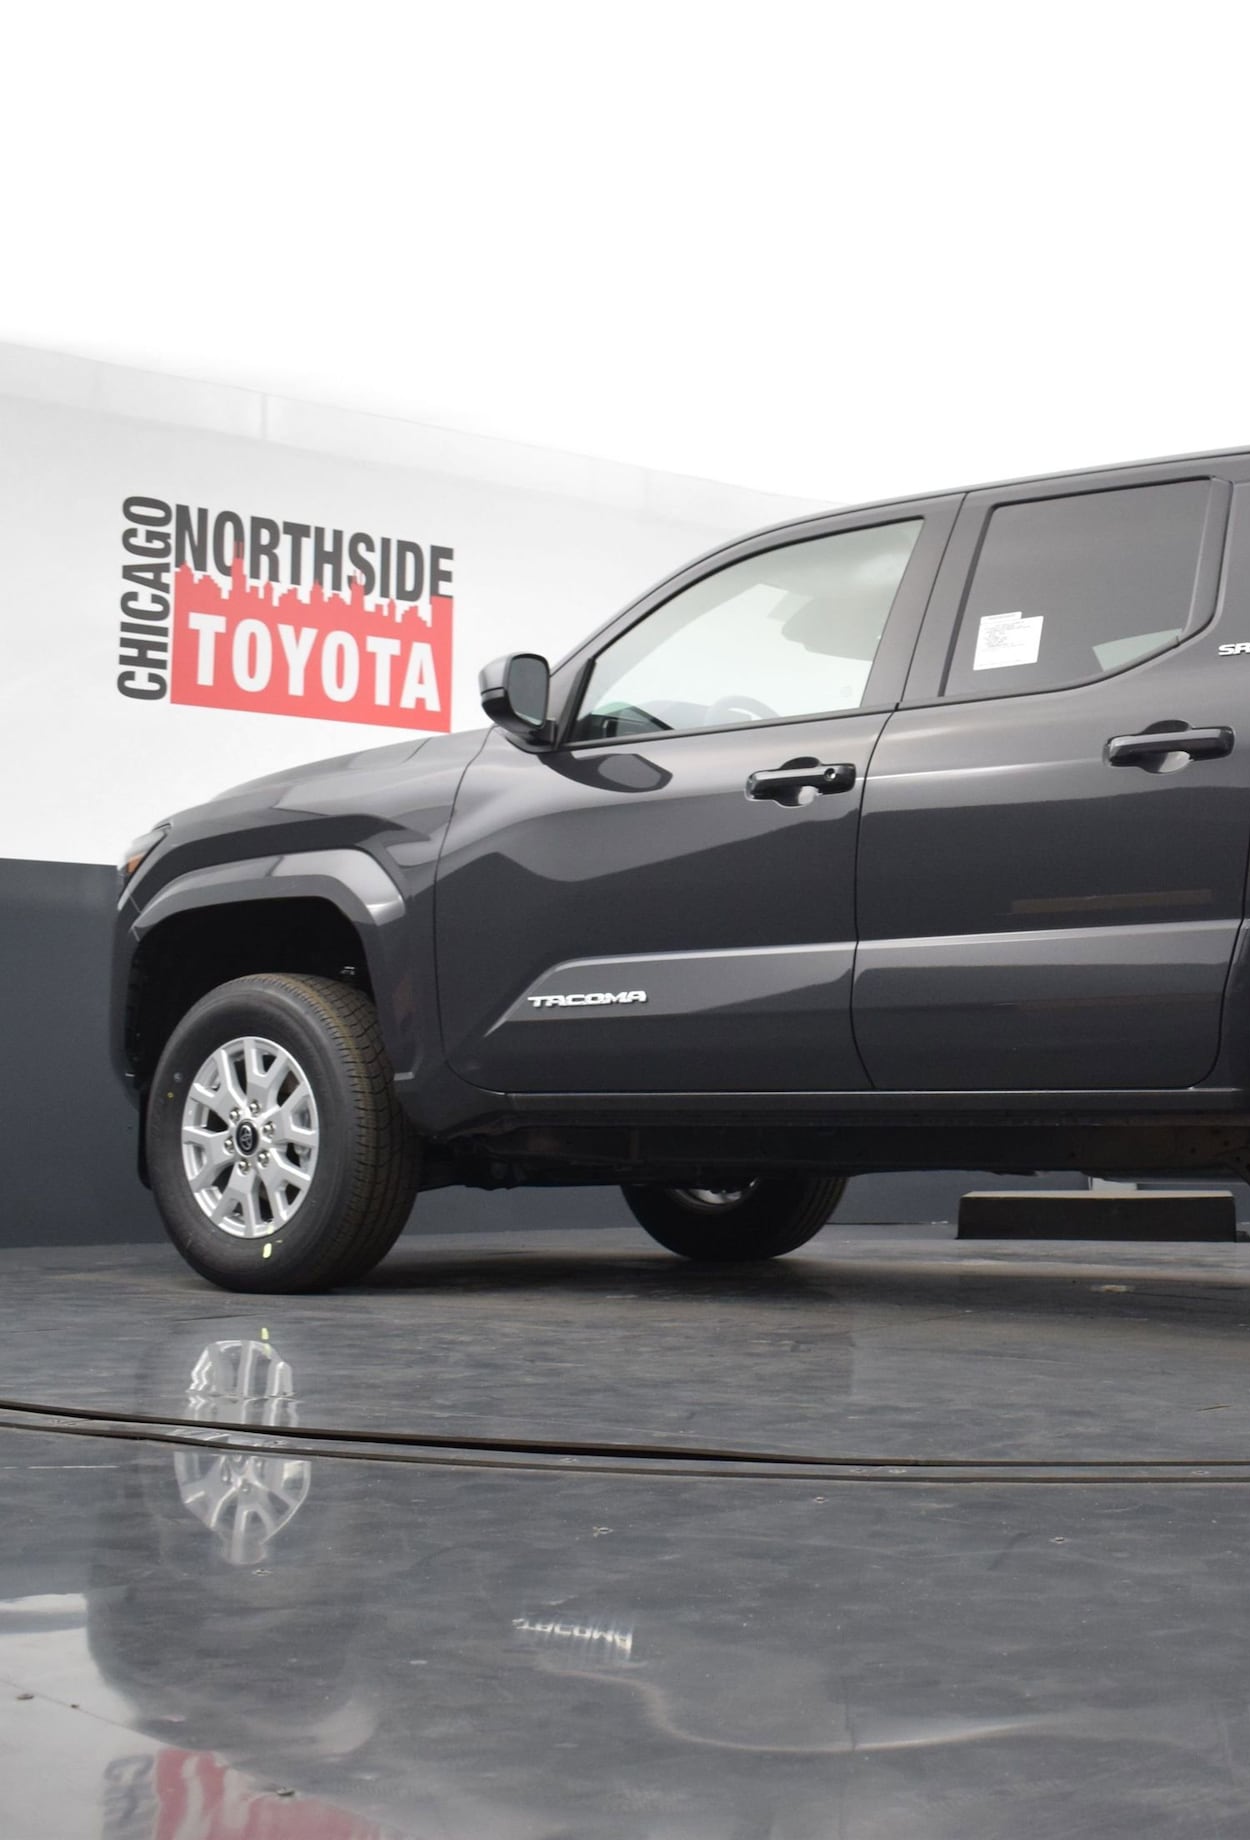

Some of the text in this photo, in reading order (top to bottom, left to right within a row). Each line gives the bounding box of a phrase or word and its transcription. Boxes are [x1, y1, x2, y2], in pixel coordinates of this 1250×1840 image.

[117, 496, 172, 701] CHICAGO
[175, 503, 454, 602] NORTHSIDE
[188, 612, 441, 712] TOYOTA
[527, 990, 647, 1007] TACOMA
